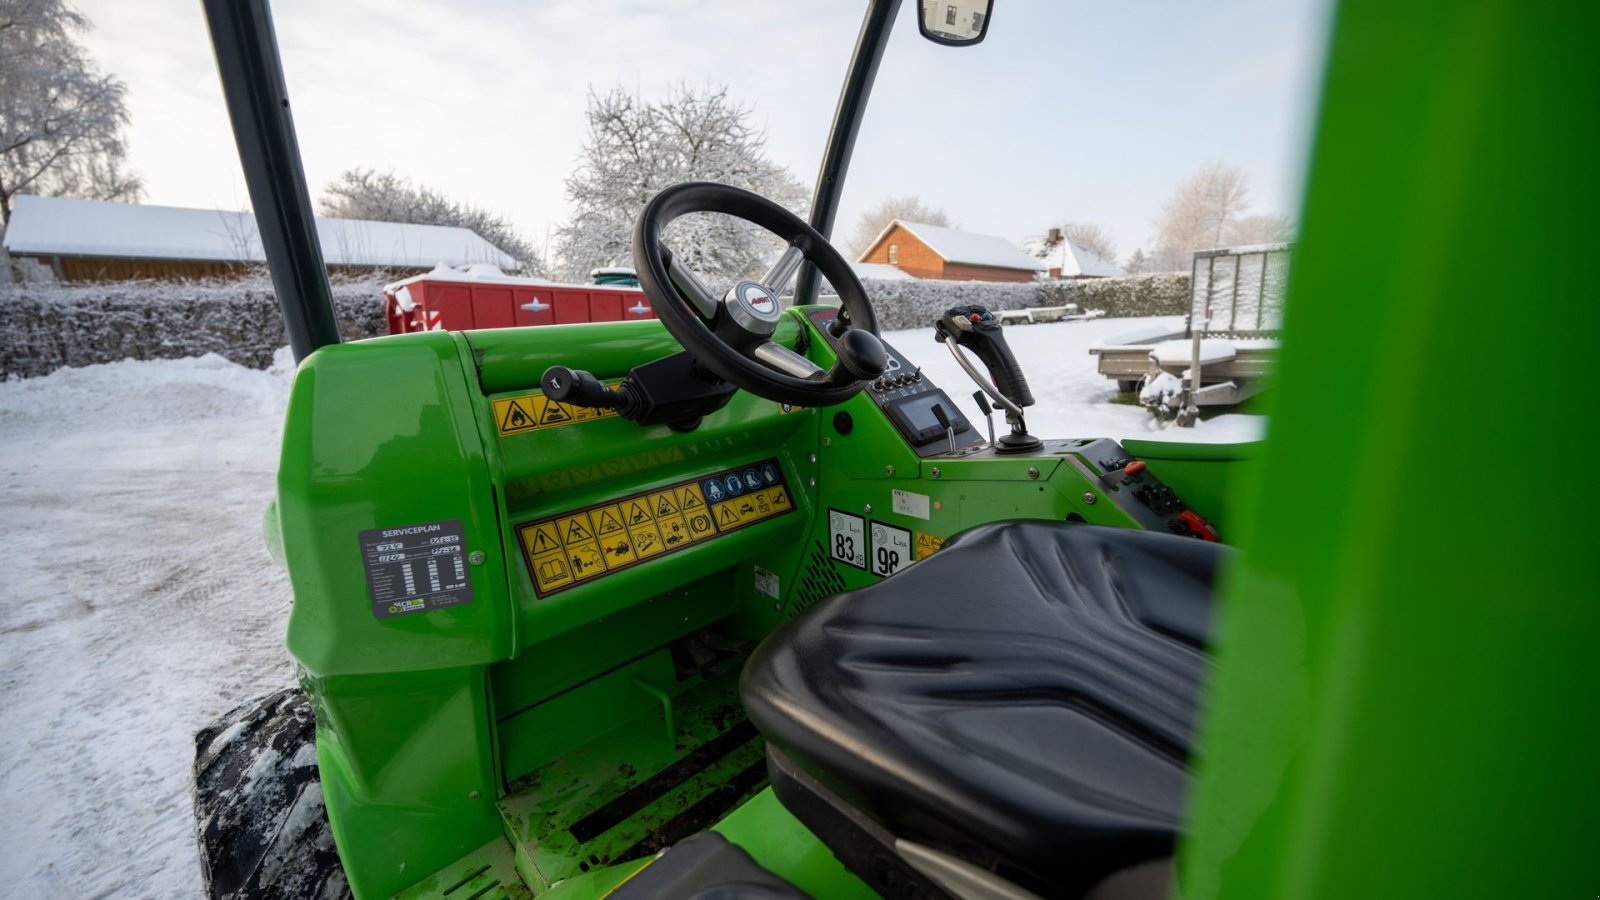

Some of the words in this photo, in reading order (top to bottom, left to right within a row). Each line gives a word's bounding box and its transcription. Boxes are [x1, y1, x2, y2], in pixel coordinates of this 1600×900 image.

[382, 524, 440, 538] SERVICEPLAN
[697, 518, 703, 529] P
[836, 533, 854, 561] 83
[855, 554, 864, 566] dB
[877, 547, 899, 574] 98
